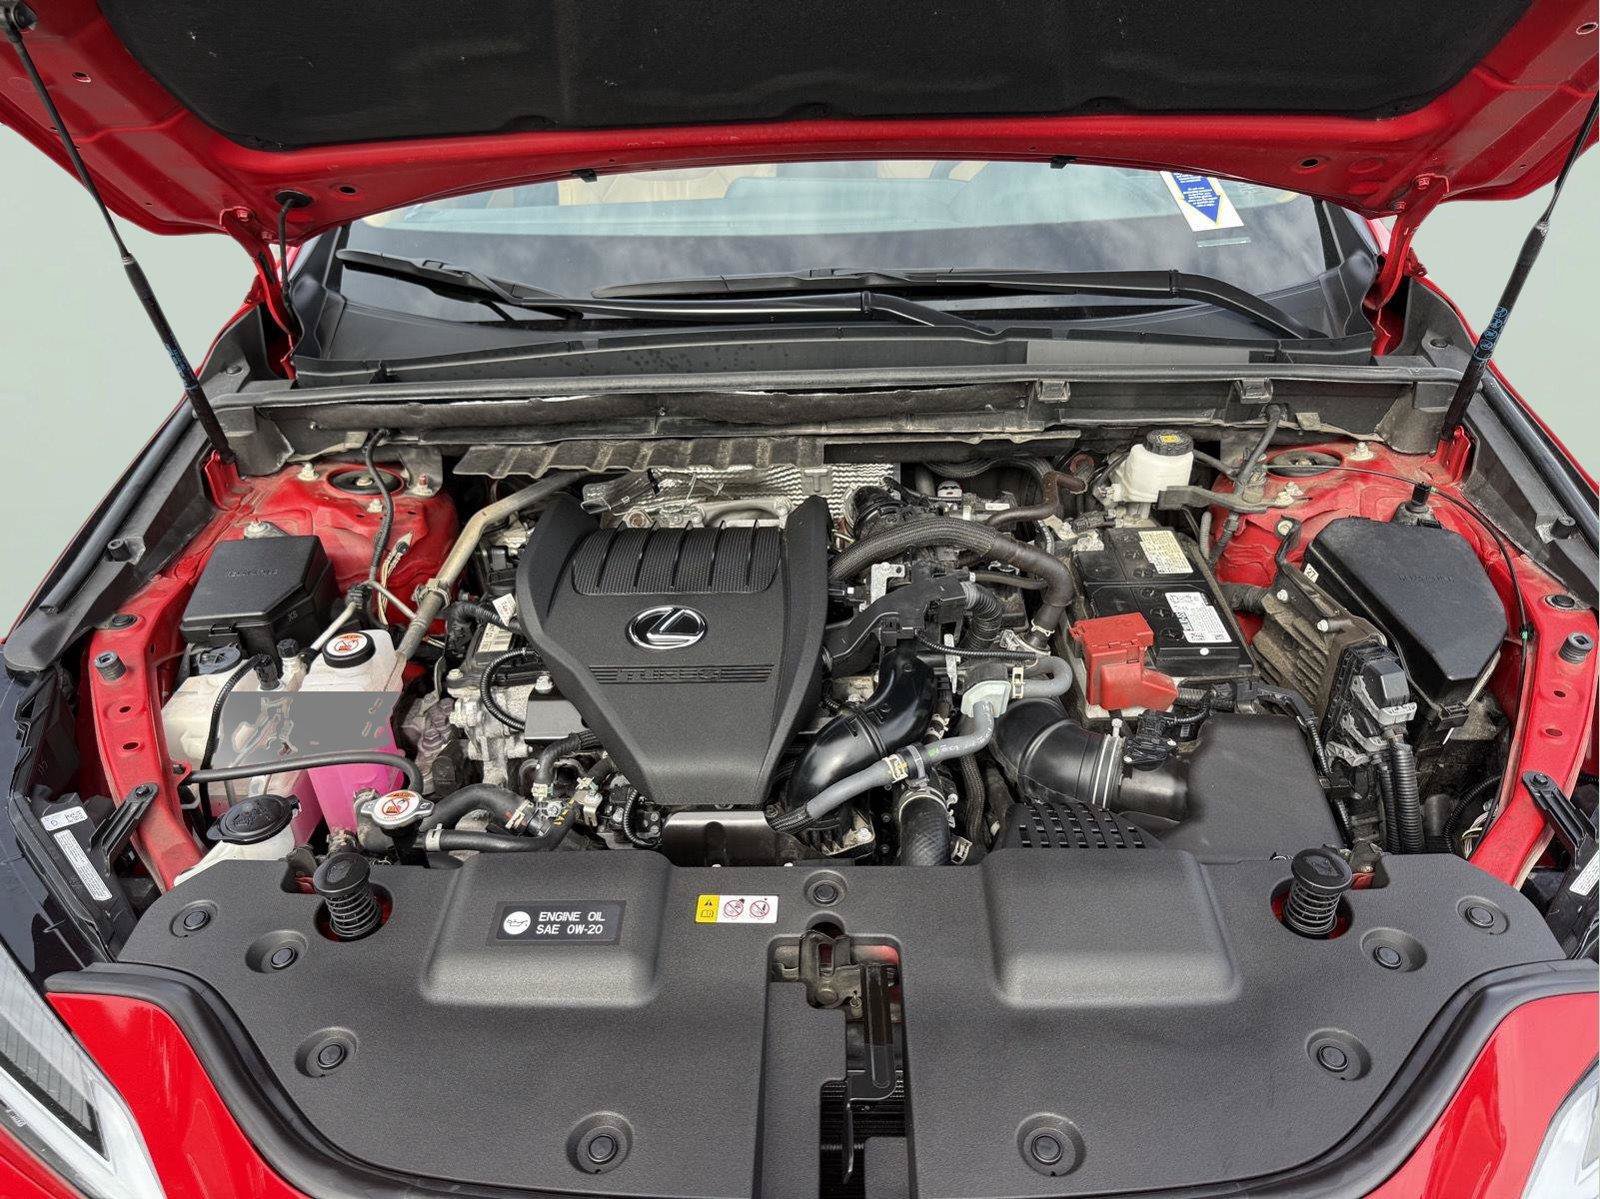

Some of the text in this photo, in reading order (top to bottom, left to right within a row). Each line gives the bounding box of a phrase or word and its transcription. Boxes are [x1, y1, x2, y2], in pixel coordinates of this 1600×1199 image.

[538, 911, 605, 921] ENGINE OIL
[536, 924, 603, 934] SAE 0W-20
